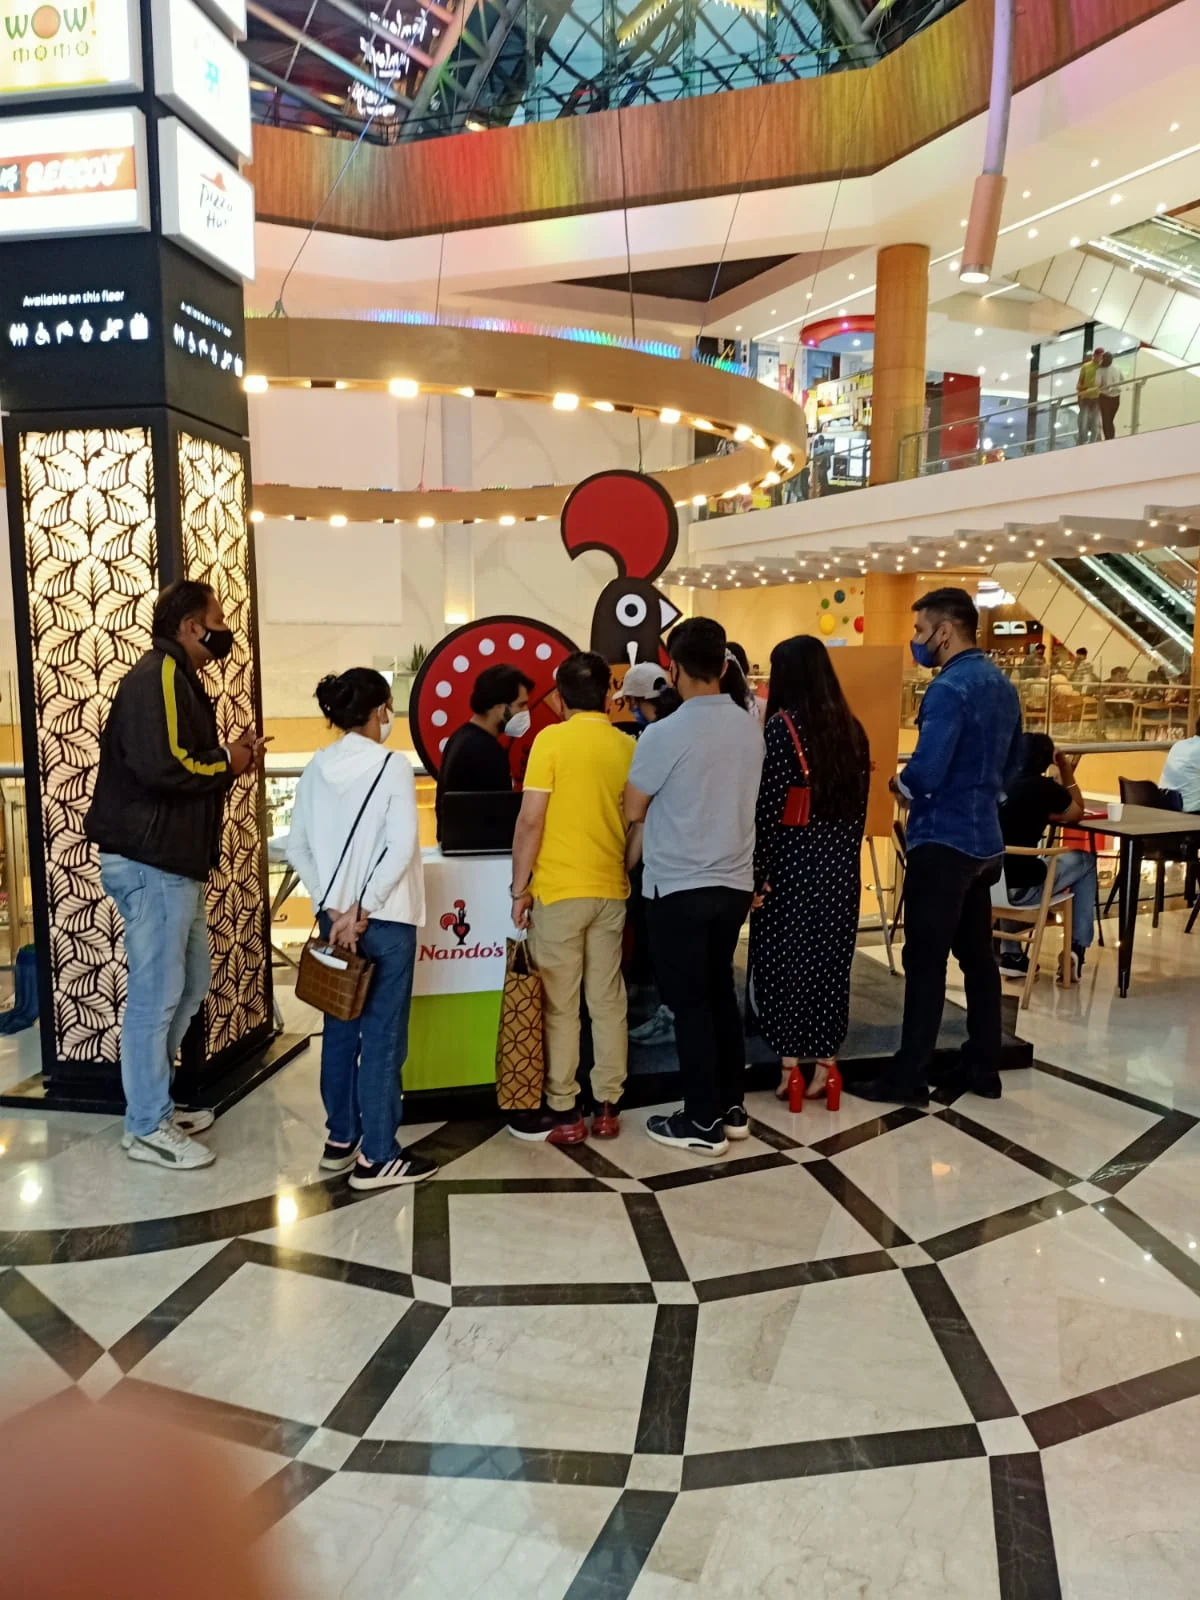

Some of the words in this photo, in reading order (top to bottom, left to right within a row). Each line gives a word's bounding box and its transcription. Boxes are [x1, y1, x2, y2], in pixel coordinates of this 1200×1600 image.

[5, 0, 96, 40] WOW!
[13, 40, 88, 63] momo
[23, 294, 67, 307] Available
[69, 293, 81, 304] on
[83, 290, 100, 303] this
[102, 289, 124, 302] floor
[418, 941, 504, 961] Nando's
